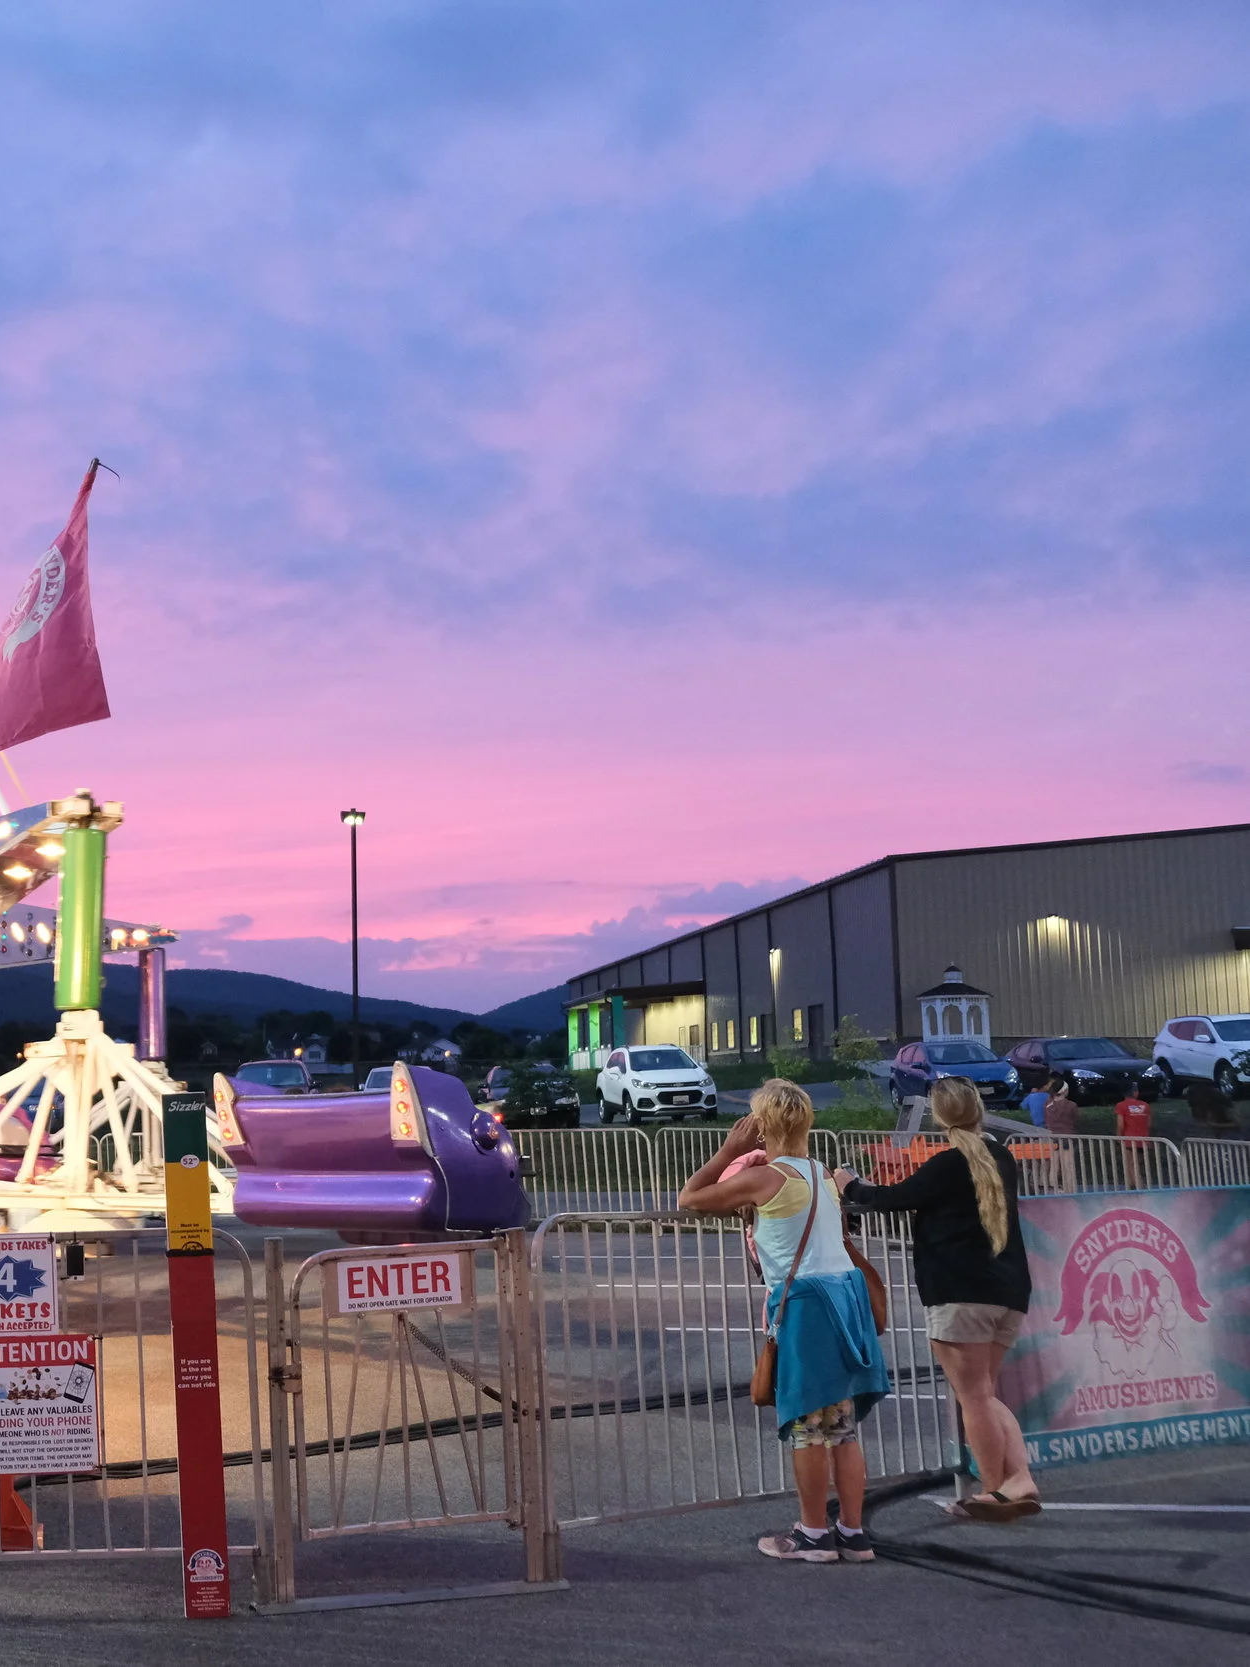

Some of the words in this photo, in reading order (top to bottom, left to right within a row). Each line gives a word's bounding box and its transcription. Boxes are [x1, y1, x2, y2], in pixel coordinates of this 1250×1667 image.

[31, 551, 62, 625] YDER'S
[168, 1101, 205, 1112] Sizzler
[16, 1241, 47, 1250] TAKES
[1073, 1219, 1180, 1274] SNYDER'S
[347, 1261, 451, 1299] ENTER
[6, 1321, 50, 1330] ACCEPTED
[1075, 1373, 1217, 1415] AMUSEMENTS
[0, 1408, 25, 1416] LEAVE
[27, 1406, 44, 1415] ANY
[46, 1405, 93, 1414] VALUABLES
[26, 1417, 54, 1427] YOUR
[57, 1415, 92, 1426] PHONE
[24, 1429, 41, 1437] WHO
[51, 1428, 65, 1436] NOT
[66, 1427, 93, 1435] RIDING.
